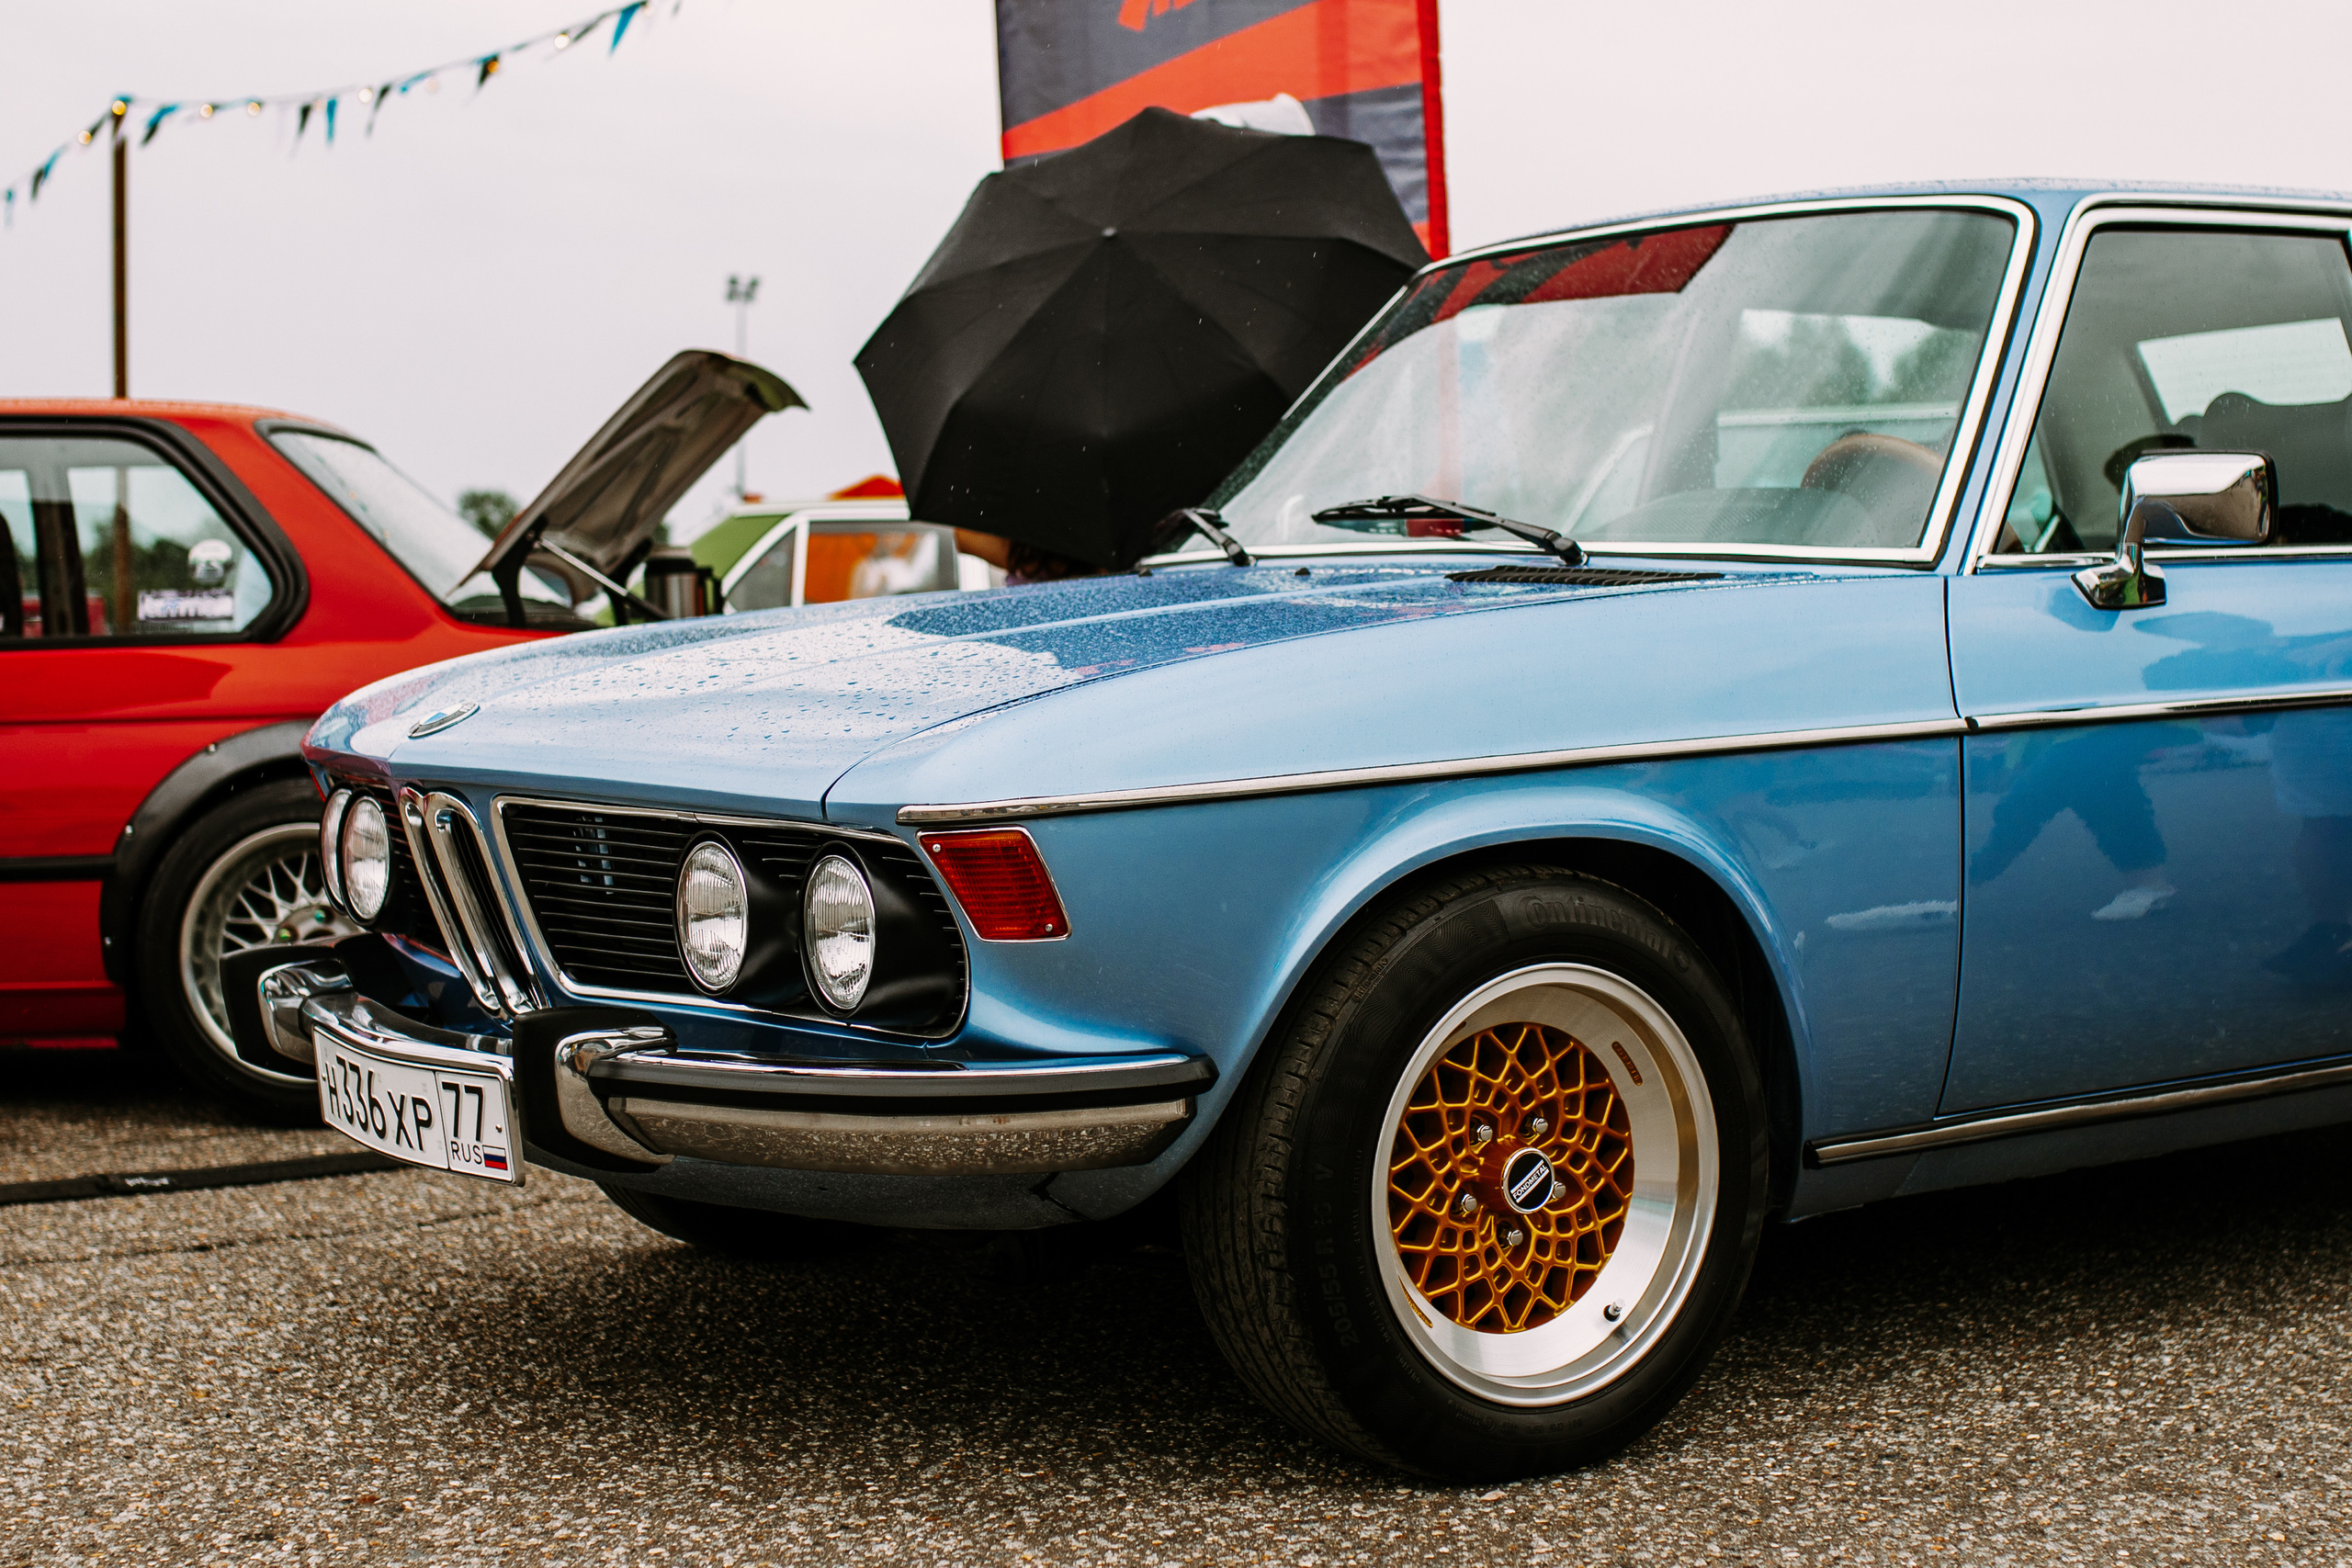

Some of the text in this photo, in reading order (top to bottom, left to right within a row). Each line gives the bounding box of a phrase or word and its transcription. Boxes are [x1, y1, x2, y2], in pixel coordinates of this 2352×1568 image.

[1516, 895, 1673, 959] Continental
[442, 1081, 483, 1141] 77
[450, 1140, 482, 1165] RUS
[1315, 1162, 1334, 1180] V
[1512, 1164, 1548, 1200] FONDMETAL
[1315, 1237, 1335, 1255] R
[1318, 1263, 1360, 1348] 205/55
